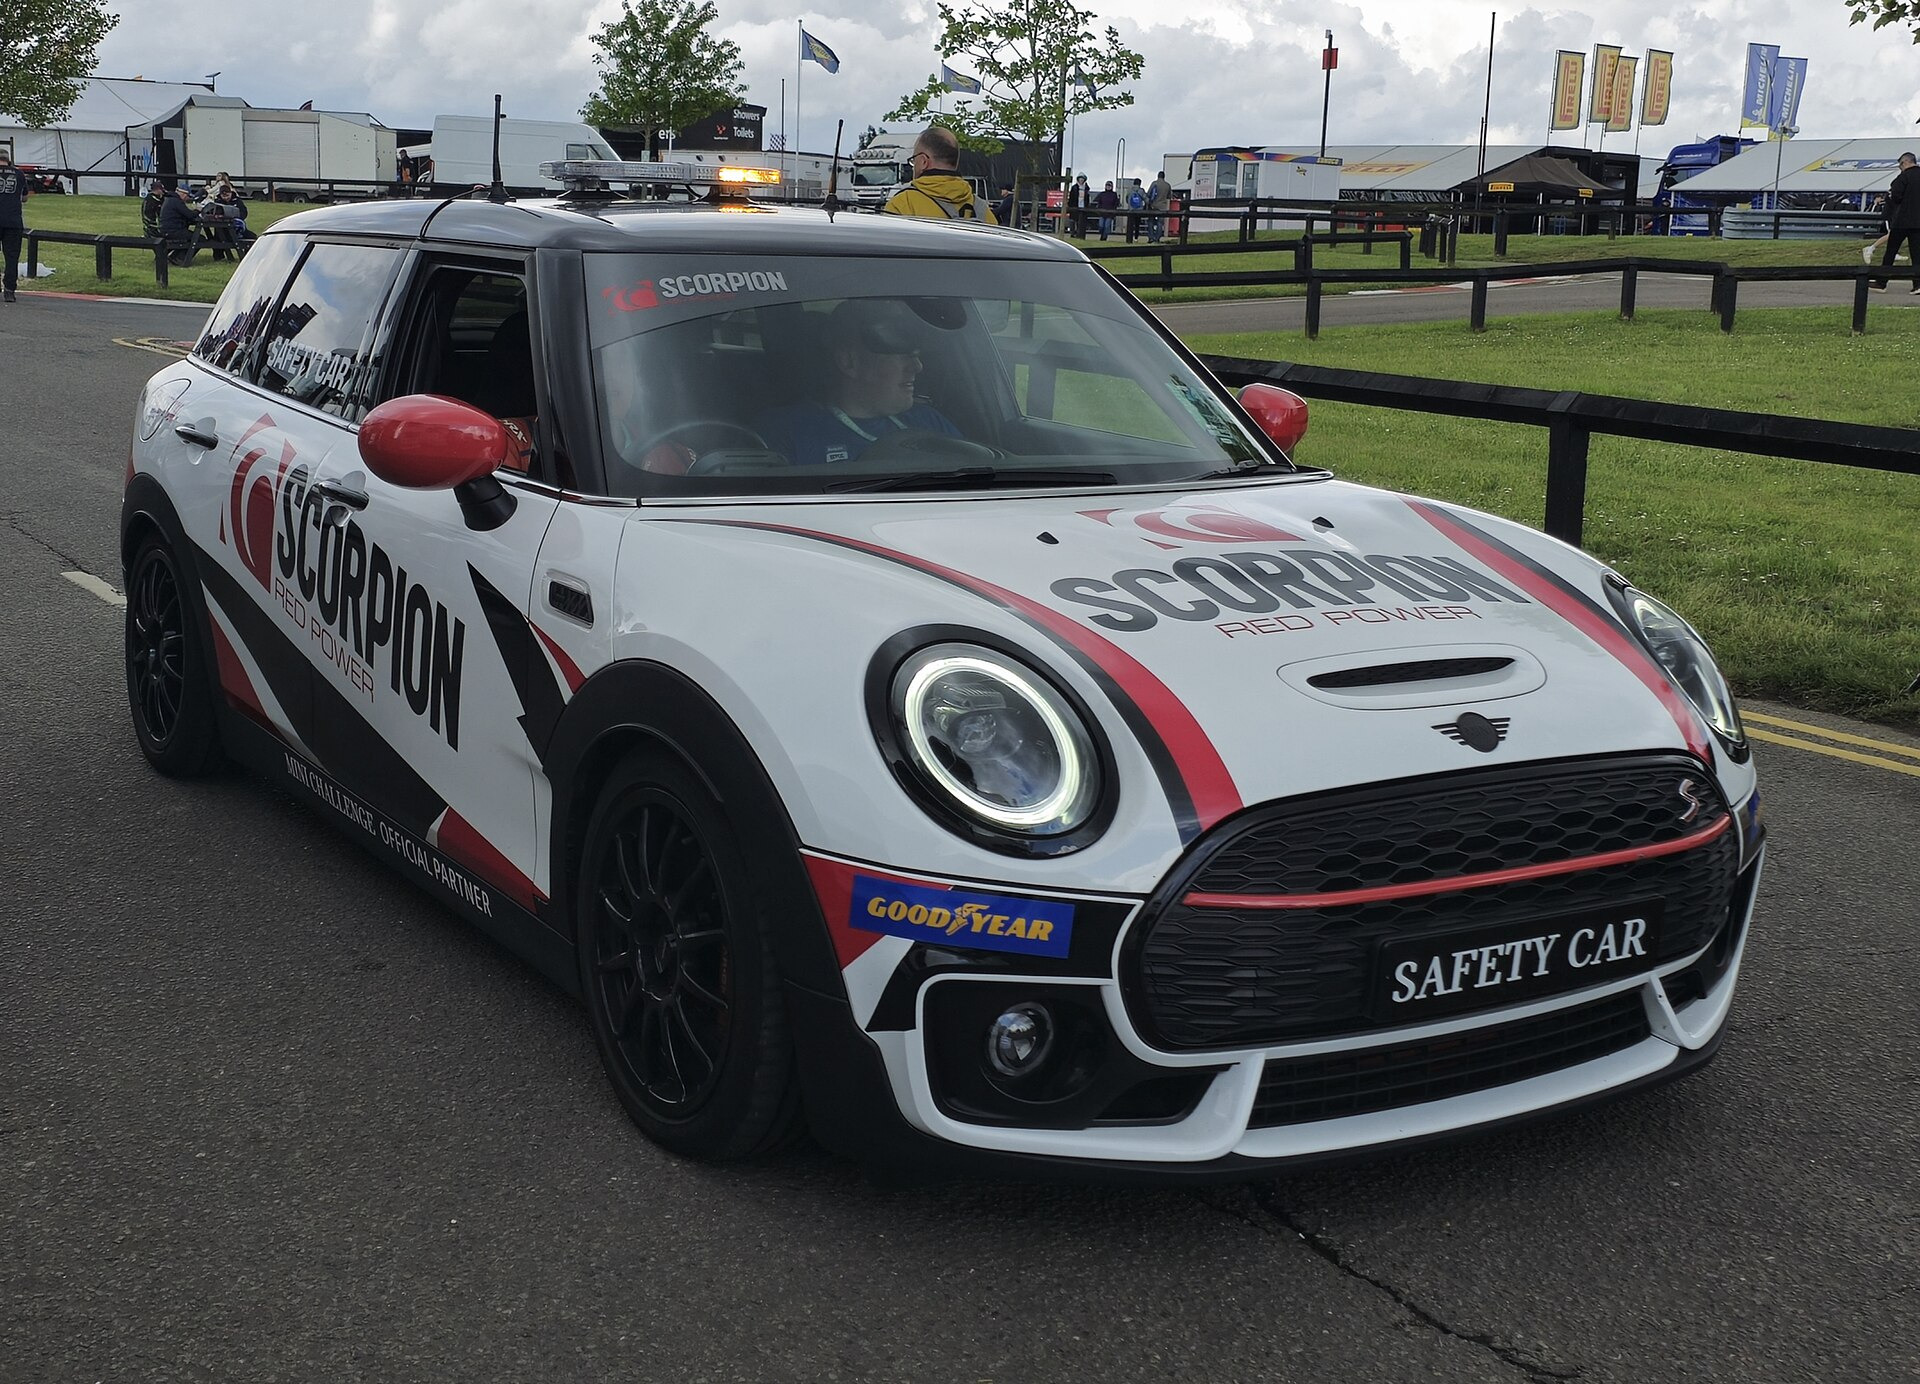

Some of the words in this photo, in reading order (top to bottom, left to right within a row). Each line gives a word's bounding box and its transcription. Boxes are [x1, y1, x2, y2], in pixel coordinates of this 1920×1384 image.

[733, 108, 760, 121] Showers
[733, 126, 755, 139] Toilets
[658, 271, 788, 298] SCORPION
[267, 335, 320, 379] SAFETY
[315, 350, 351, 390] CAR
[276, 463, 466, 752] SCORPION
[1049, 548, 1531, 632] SCORPION
[1214, 614, 1314, 639] RED
[1320, 605, 1483, 627] POWER
[274, 576, 306, 629] RED
[311, 617, 375, 703] POWER
[284, 752, 311, 788] MINI
[310, 771, 376, 836] CHALLENGE
[379, 820, 433, 876] OFFICIAL
[433, 857, 493, 918] PARTNER
[1391, 933, 1561, 1003] SAFETY
[1567, 918, 1647, 968] CAR
